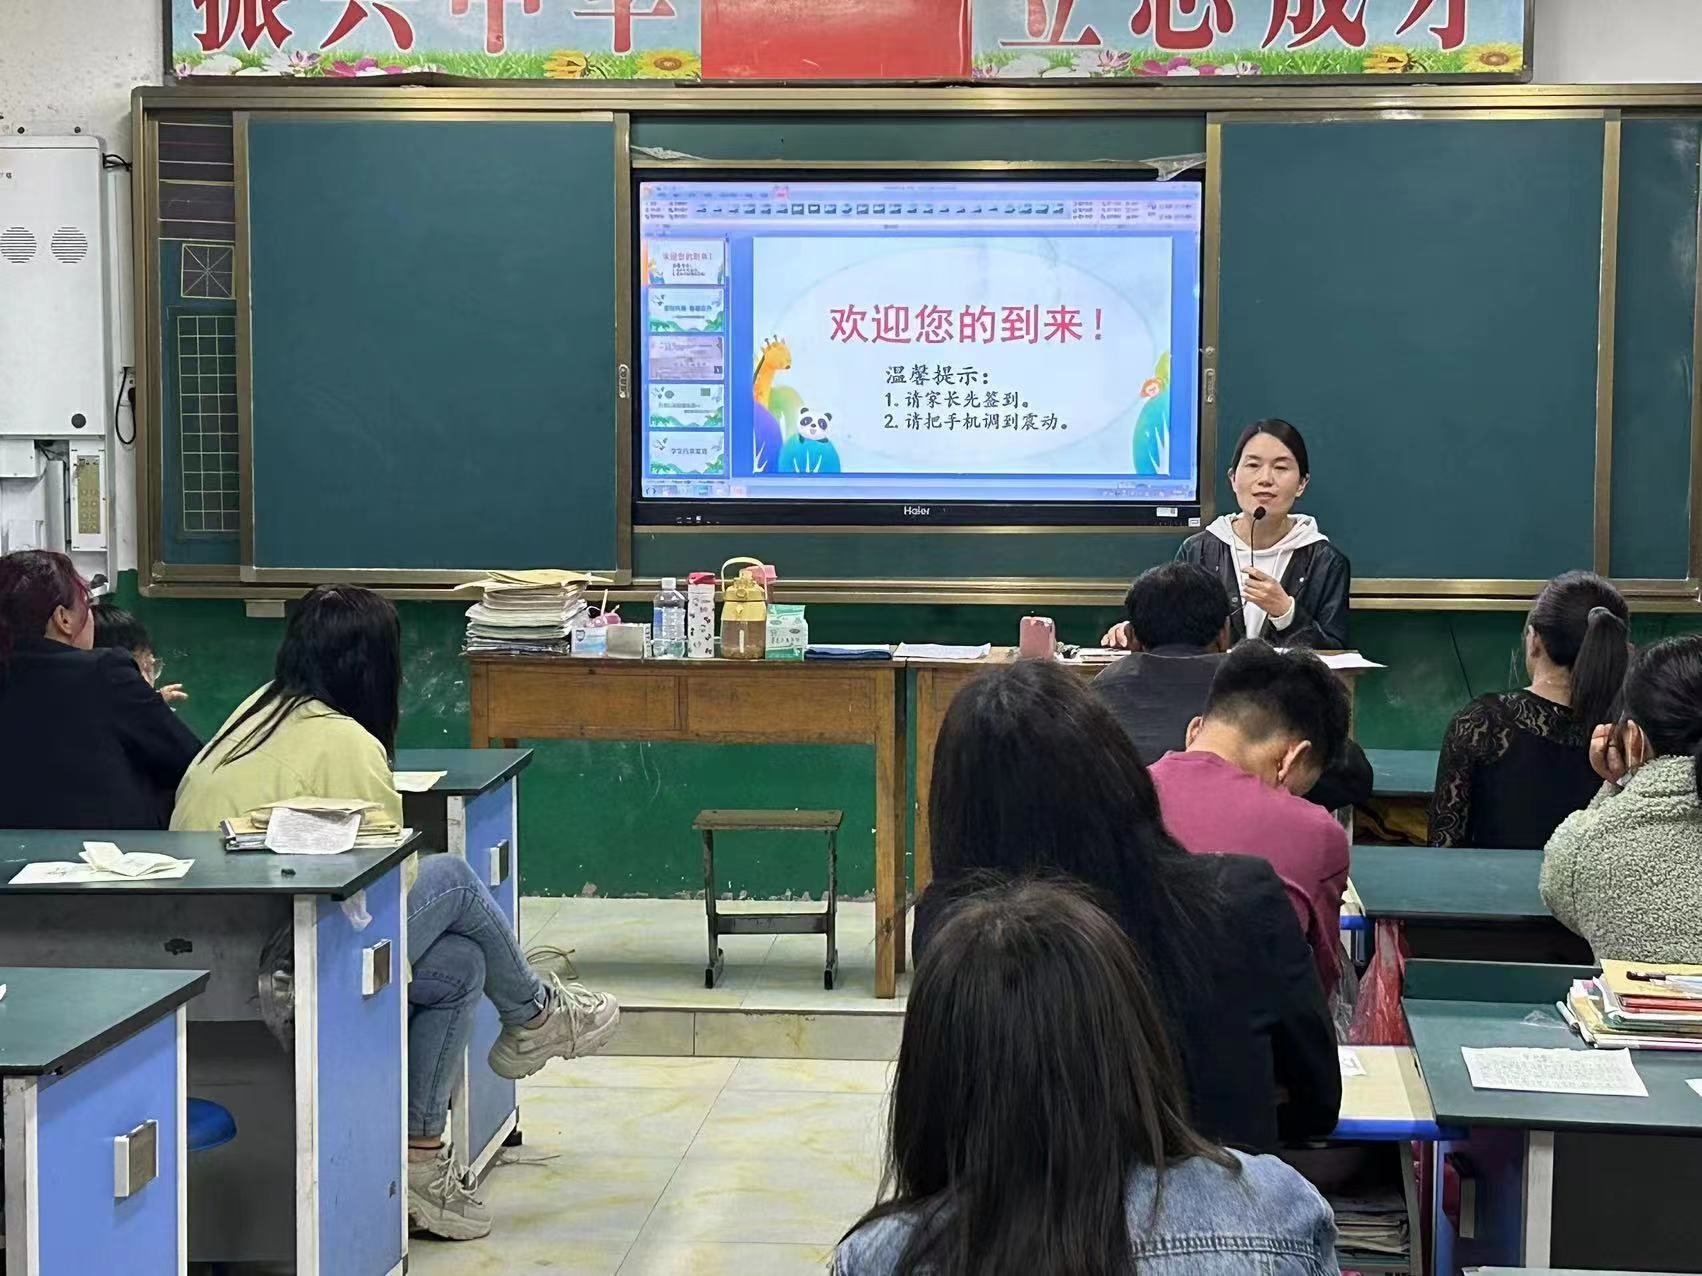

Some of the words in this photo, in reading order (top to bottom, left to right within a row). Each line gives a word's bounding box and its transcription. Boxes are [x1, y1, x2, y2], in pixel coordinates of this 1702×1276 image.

[829, 303, 1102, 344] 欢迎您的到来！
[885, 364, 989, 386] 温馨提示：
[903, 505, 930, 515] Haier
